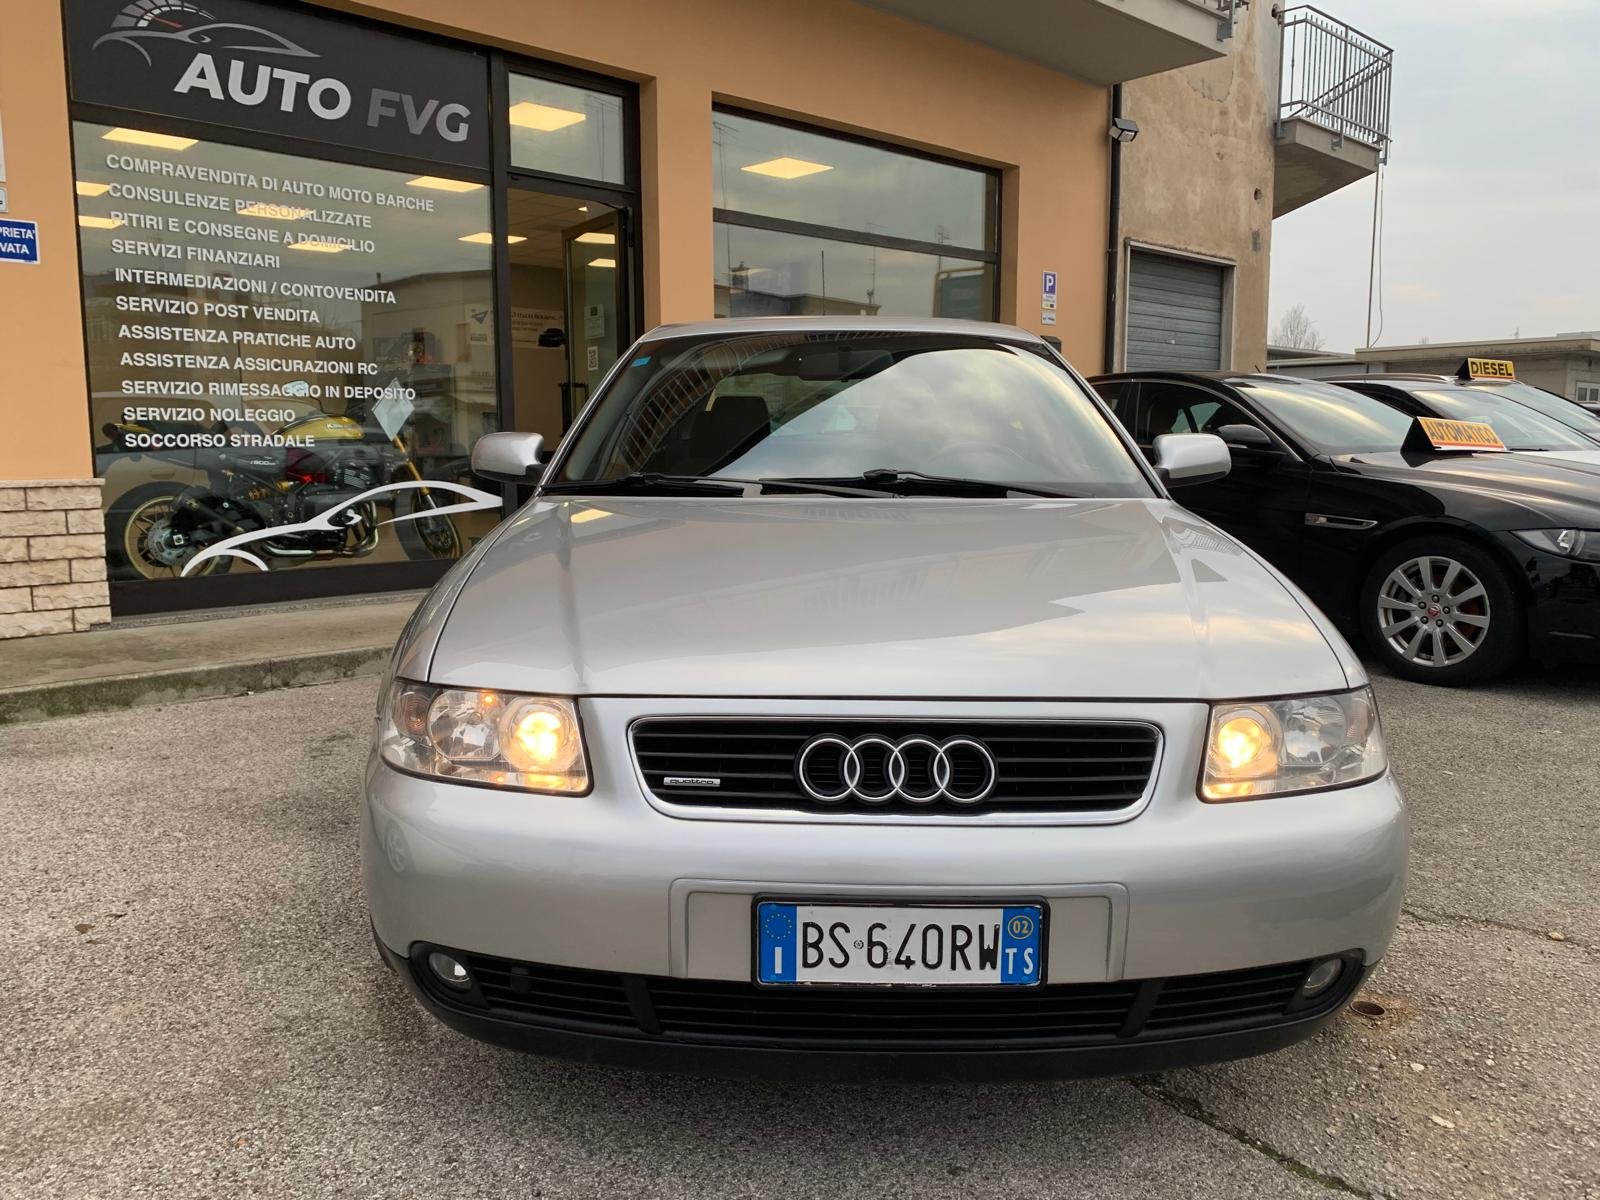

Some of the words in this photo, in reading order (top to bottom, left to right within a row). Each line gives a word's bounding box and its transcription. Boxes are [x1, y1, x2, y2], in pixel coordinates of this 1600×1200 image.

[173, 53, 351, 120] AUTO
[366, 87, 471, 142] FVG
[106, 154, 258, 188] COMPRAVENDITA
[262, 176, 278, 191] DI
[282, 180, 324, 197] AUTO
[329, 186, 372, 203] MOTO
[376, 192, 434, 212] BARCHE
[108, 183, 230, 211] CONSULENZE
[235, 199, 372, 228] PERSONALIZZATE
[0, 226, 35, 239] RIETA'
[110, 211, 163, 230] RITIRI
[169, 218, 180, 232] E
[184, 220, 279, 243] CONSEGNE
[283, 231, 294, 244] A
[297, 232, 375, 253] DOMICILIO
[111, 239, 182, 259] SERVIZI
[186, 247, 280, 268] FINANZIARI
[115, 268, 266, 293] INTERMEDIAZIONI
[271, 282, 277, 294] /
[280, 282, 397, 304] CONTOVENDITA
[1046, 275, 1054, 291] P
[116, 295, 198, 315] SERVIZIO
[204, 303, 248, 318] POST
[253, 306, 320, 323] VENDITA
[118, 324, 229, 344] ASSISTENZA
[233, 331, 311, 348] PRATICHE
[315, 336, 356, 350] AUTO
[120, 352, 230, 369] ASSISTENZA
[234, 357, 353, 374] ASSICURAZIONI
[357, 363, 378, 375] RC
[1470, 361, 1513, 376] DIESEL
[121, 380, 203, 395] SERVIZIO
[325, 386, 340, 398] IN
[344, 387, 416, 400] DEPOSITO
[123, 407, 205, 421] SERVIZIO
[210, 408, 296, 422] NOLEGGIO
[125, 433, 226, 448] SOCCORSO
[230, 434, 315, 447] STRADALE
[1425, 421, 1499, 444] AUTOMATICO
[1012, 920, 1029, 935] 02
[774, 946, 782, 974] I
